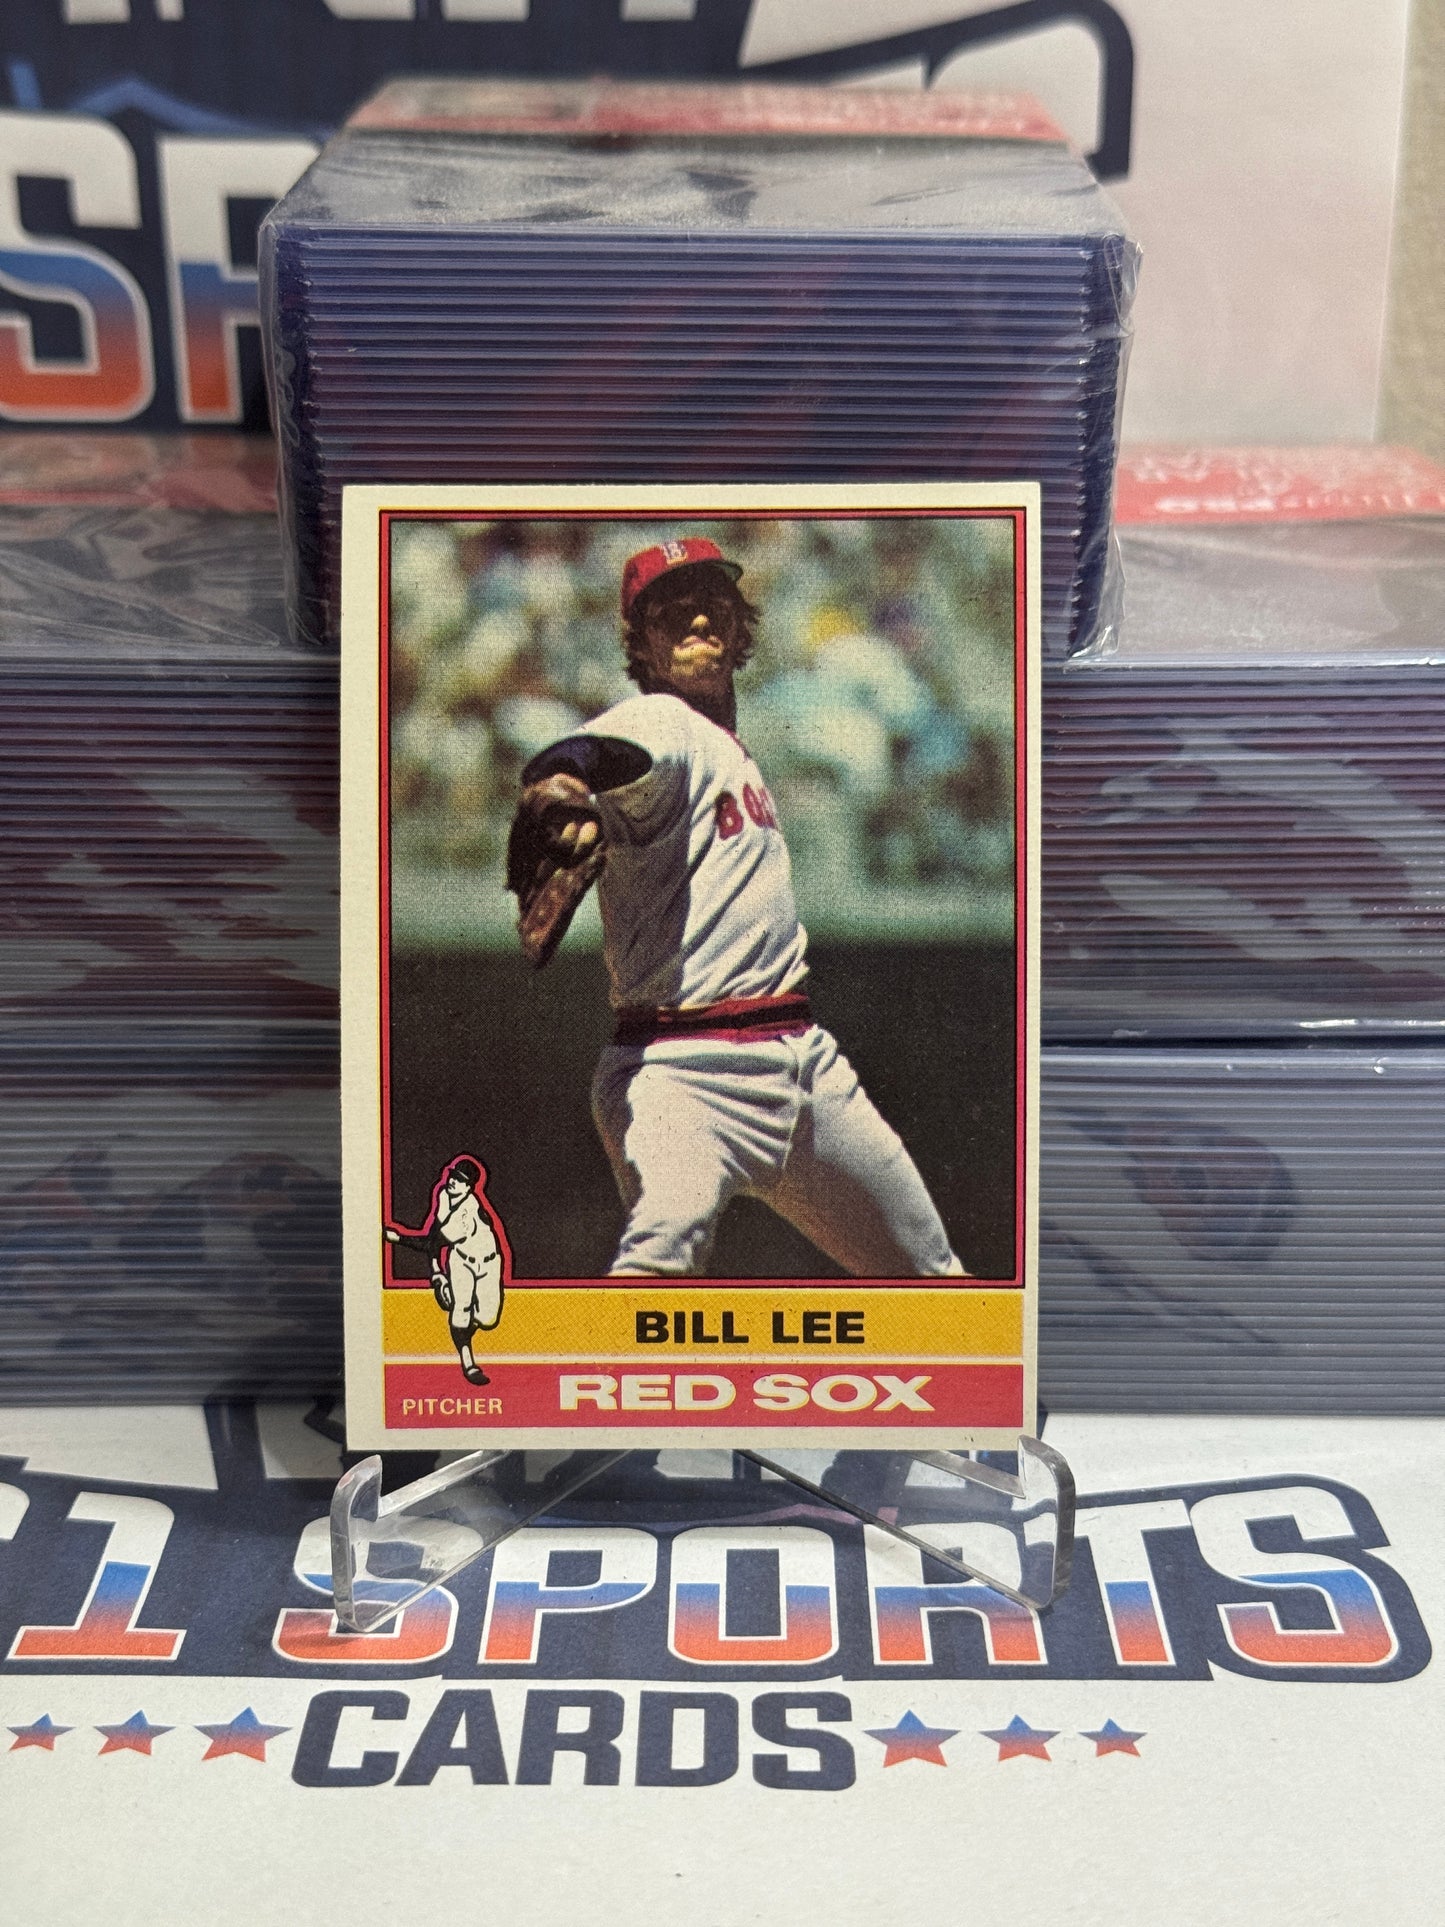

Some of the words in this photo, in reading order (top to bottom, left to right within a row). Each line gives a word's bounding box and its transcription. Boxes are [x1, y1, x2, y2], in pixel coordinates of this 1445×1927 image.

[636, 1311, 749, 1345] BILL
[772, 1310, 866, 1344] LEE
[402, 1397, 504, 1416] PITCHER
[559, 1374, 737, 1412] RED
[752, 1373, 936, 1413] SOX
[272, 1486, 1399, 1666] SPORTS
[291, 1689, 857, 1791] CARDS
